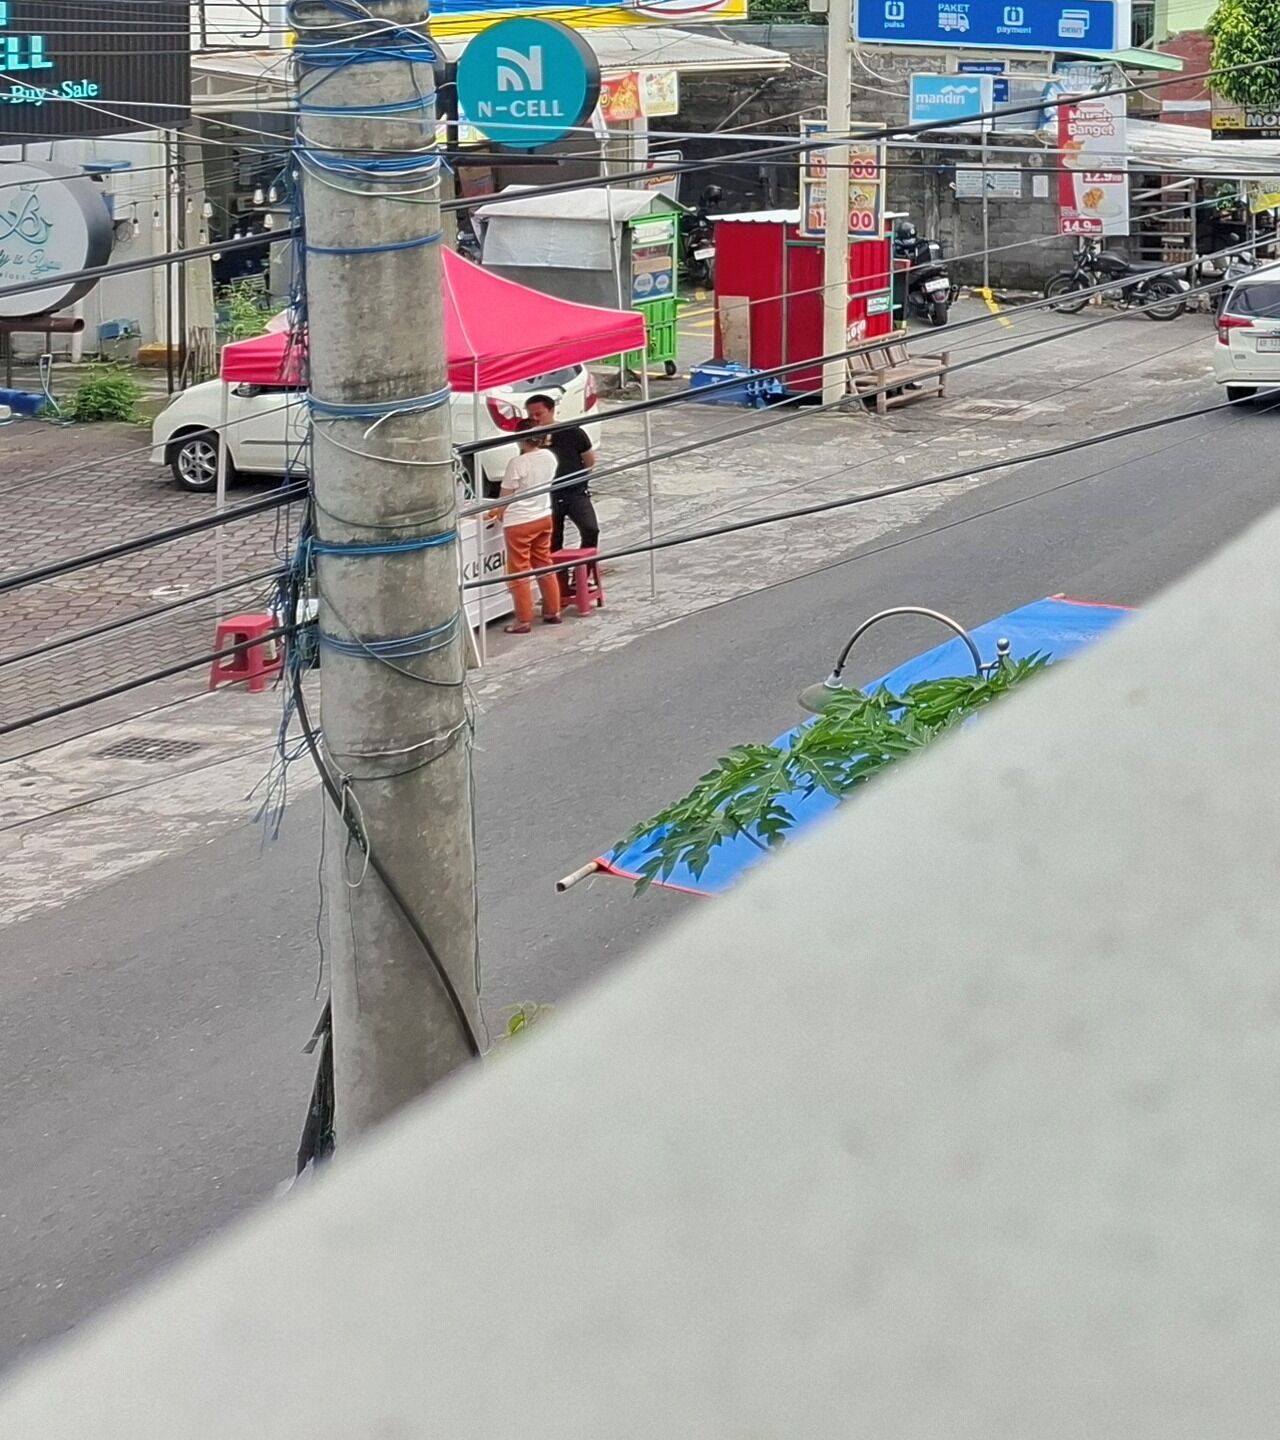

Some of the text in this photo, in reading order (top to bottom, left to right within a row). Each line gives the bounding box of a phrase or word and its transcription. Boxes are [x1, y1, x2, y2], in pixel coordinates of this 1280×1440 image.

[938, 3, 971, 13] PAKET
[884, 20, 905, 29] pulsa
[996, 26, 1032, 36] payment
[61, 79, 99, 99] Sale
[915, 91, 966, 105] mandiri
[478, 99, 565, 118] N-CELL
[1068, 110, 1113, 123] Murah
[1067, 124, 1115, 137] Banget
